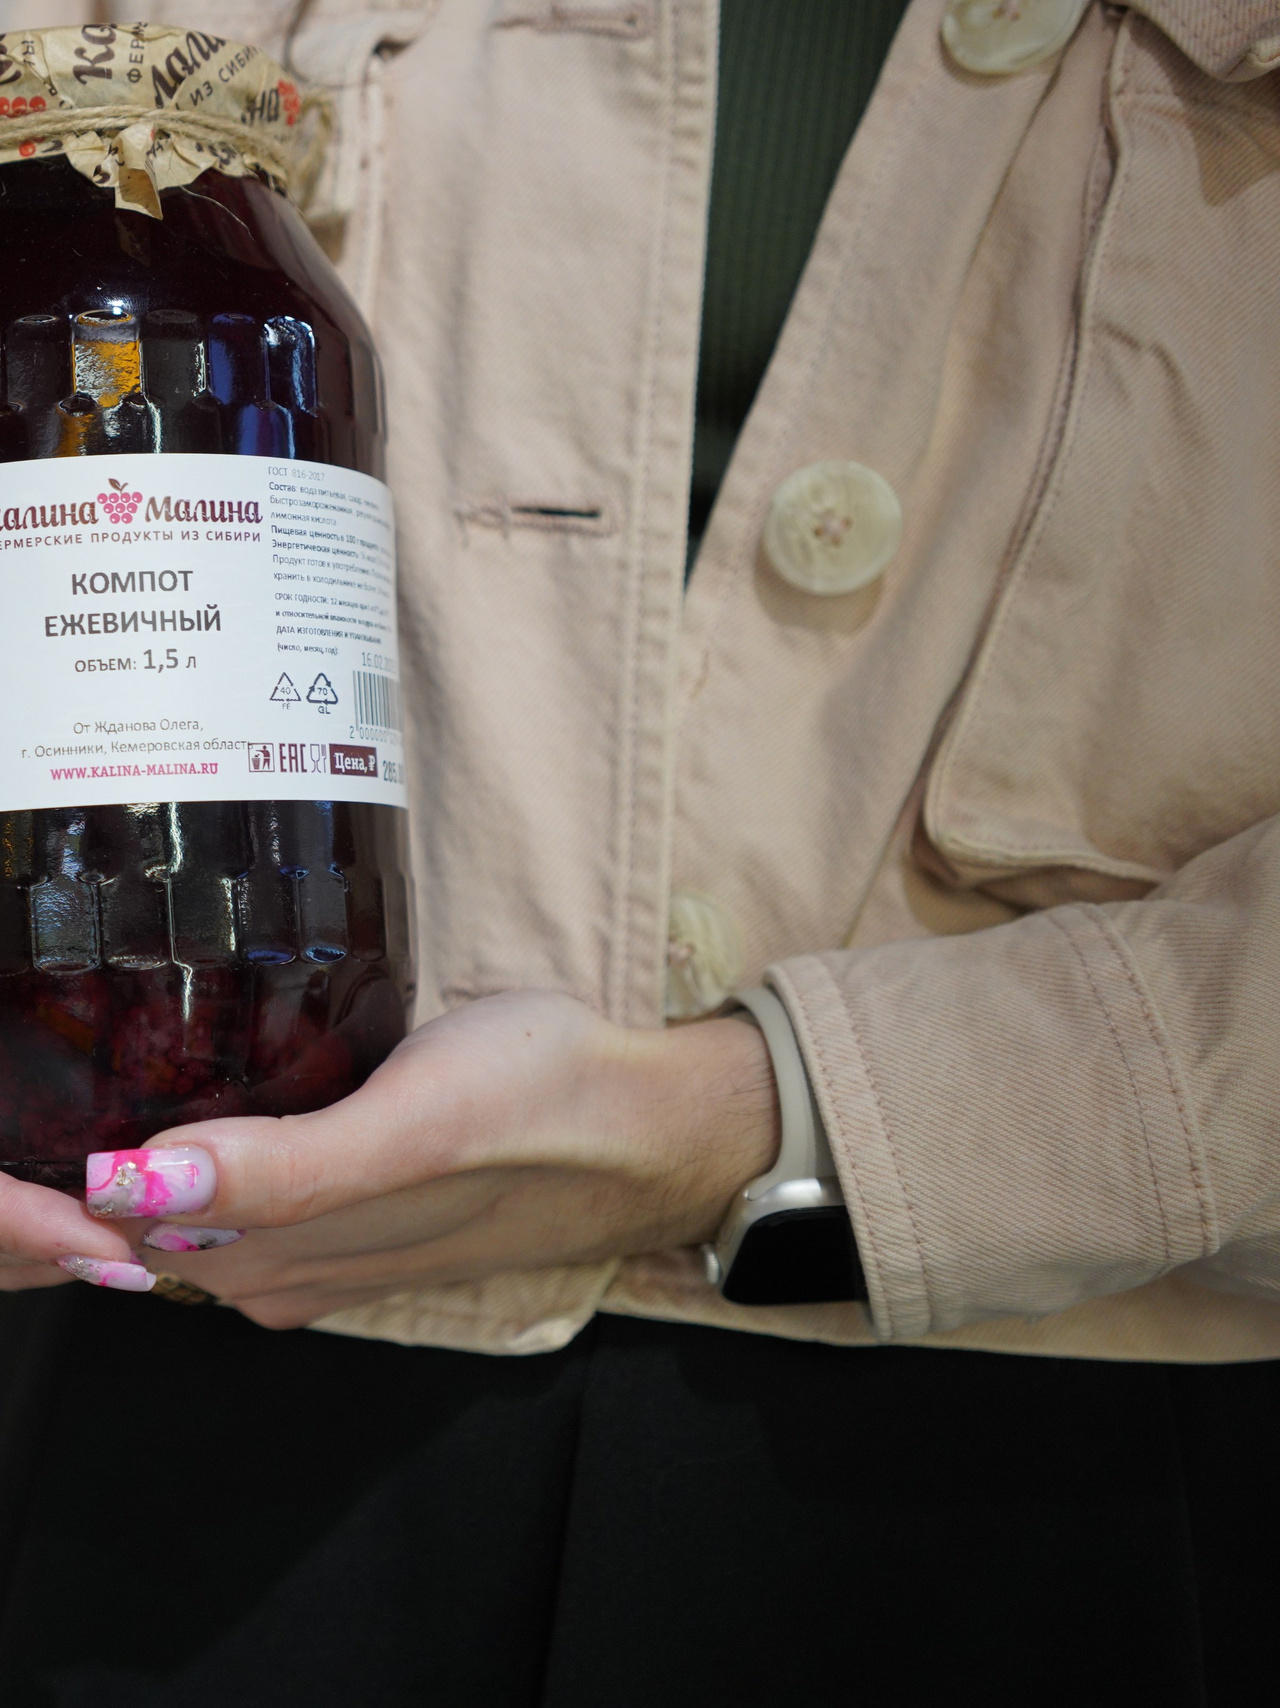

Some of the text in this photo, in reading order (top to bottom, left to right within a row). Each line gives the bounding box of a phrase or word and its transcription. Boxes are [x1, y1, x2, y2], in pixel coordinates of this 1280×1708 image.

[268, 466, 288, 477] ГОСТ
[144, 495, 264, 525] Малина
[91, 531, 173, 545] ПРОДУКТЫ
[181, 530, 200, 541] ИЗ
[206, 529, 261, 543] СИБИРИ
[271, 525, 307, 537] Пищевая
[272, 539, 330, 553] Энергетическая
[273, 554, 305, 565] Продукт
[71, 570, 193, 595] КОМПОТ
[274, 572, 304, 582] хранить
[275, 593, 292, 601] СРОК
[45, 604, 222, 638] ЕЖЕВИЧНЫЙ
[276, 626, 295, 635] ДАТА
[74, 648, 197, 674] ОБЪЕМ: 1,5 л
[280, 687, 291, 695] 40
[317, 687, 328, 696] 70
[73, 718, 204, 736] От Жданова Олега,
[21, 750, 30, 759] г.
[35, 743, 107, 758] Осинники,
[111, 739, 200, 755] Кемеровская
[334, 752, 367, 773] Цена,
[50, 763, 218, 781] WWW.KALINA-MALINA.RU
